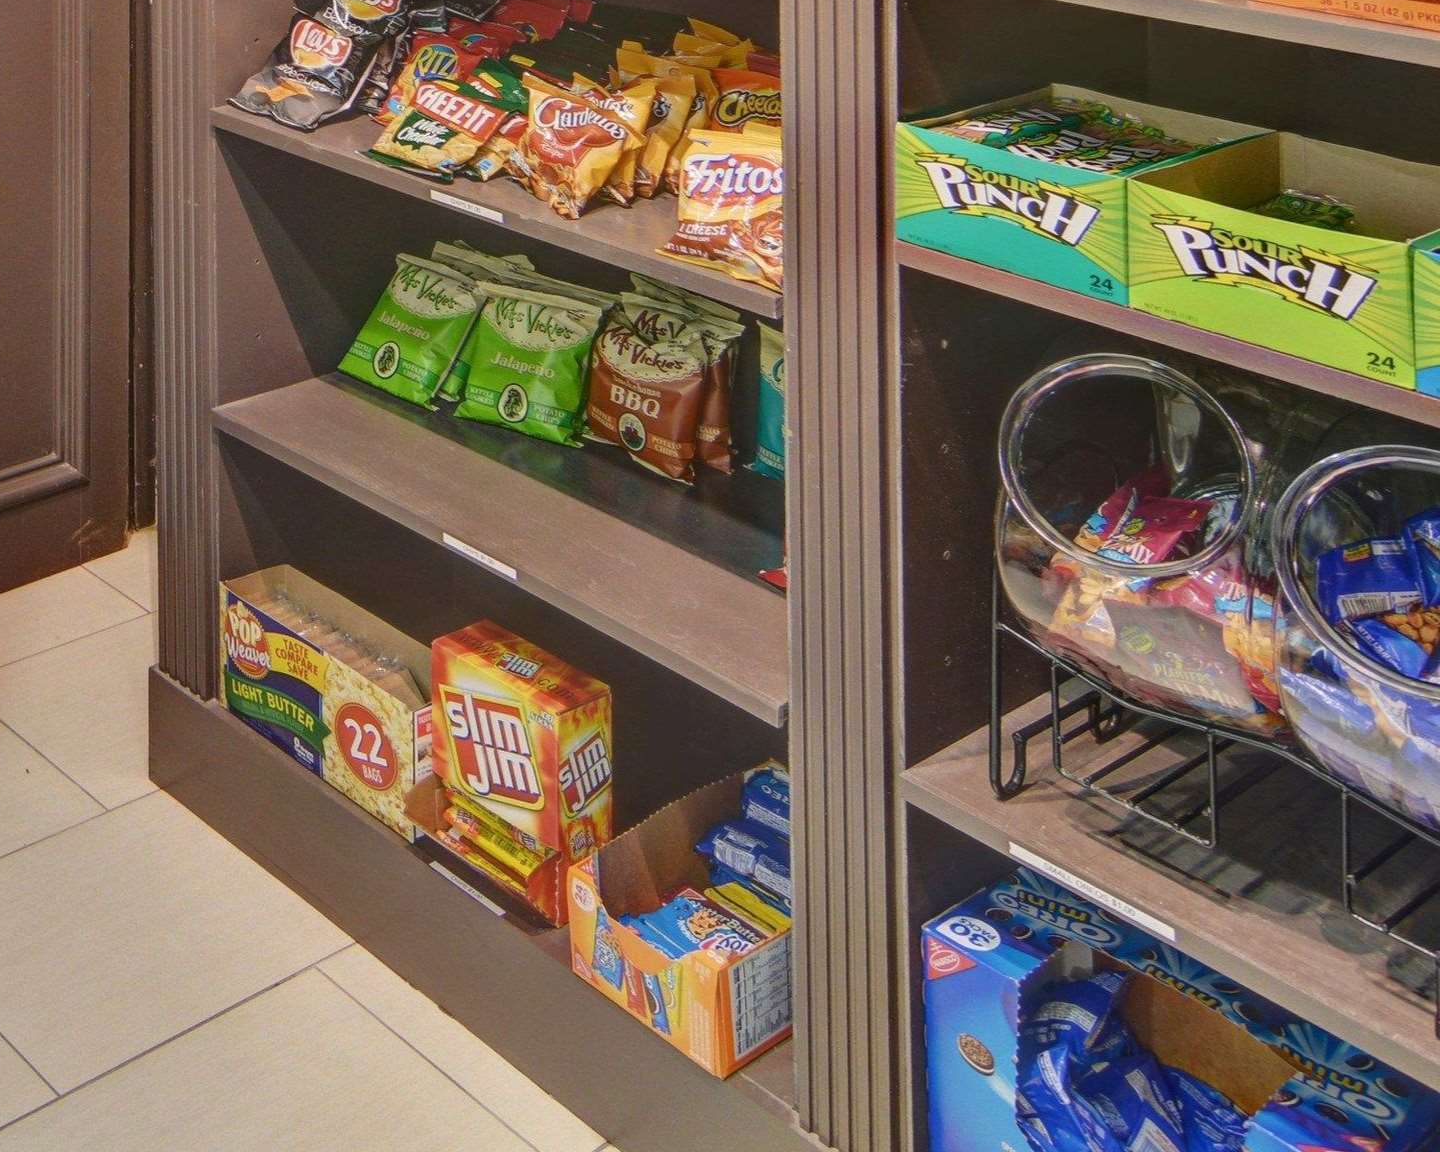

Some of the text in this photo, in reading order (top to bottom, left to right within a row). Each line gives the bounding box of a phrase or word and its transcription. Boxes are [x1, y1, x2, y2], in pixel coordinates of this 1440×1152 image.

[1344, 0, 1361, 12] 1.5
[1364, 2, 1379, 14] OZ
[1381, 5, 1399, 18] (42
[417, 47, 458, 77] RITZ
[416, 85, 496, 134] CHEEZ-IT
[685, 152, 783, 196] Fritos
[966, 164, 1041, 198] SOUR
[916, 160, 1101, 247] PUNCH
[686, 222, 728, 236] CHEESE
[1210, 228, 1305, 268] SOUR
[1089, 274, 1114, 292] 24
[1151, 223, 1378, 321] PUNCH
[490, 351, 556, 379] Jalapeño
[1366, 352, 1396, 371] 24
[1366, 365, 1396, 377] COUNT
[609, 383, 661, 420] BBQ
[228, 609, 262, 646] POP
[224, 633, 273, 670] Weaver
[274, 647, 320, 676] COMPARE
[283, 638, 310, 659] TASTE
[287, 661, 310, 680] SAVE
[231, 678, 316, 732] LIGHT BUTTER
[343, 717, 388, 768] 22
[361, 764, 383, 784] BAGS
[995, 892, 1118, 944] OREO
[1017, 889, 1090, 923] mini
[949, 920, 991, 948] 30
[960, 917, 998, 941] PACKS
